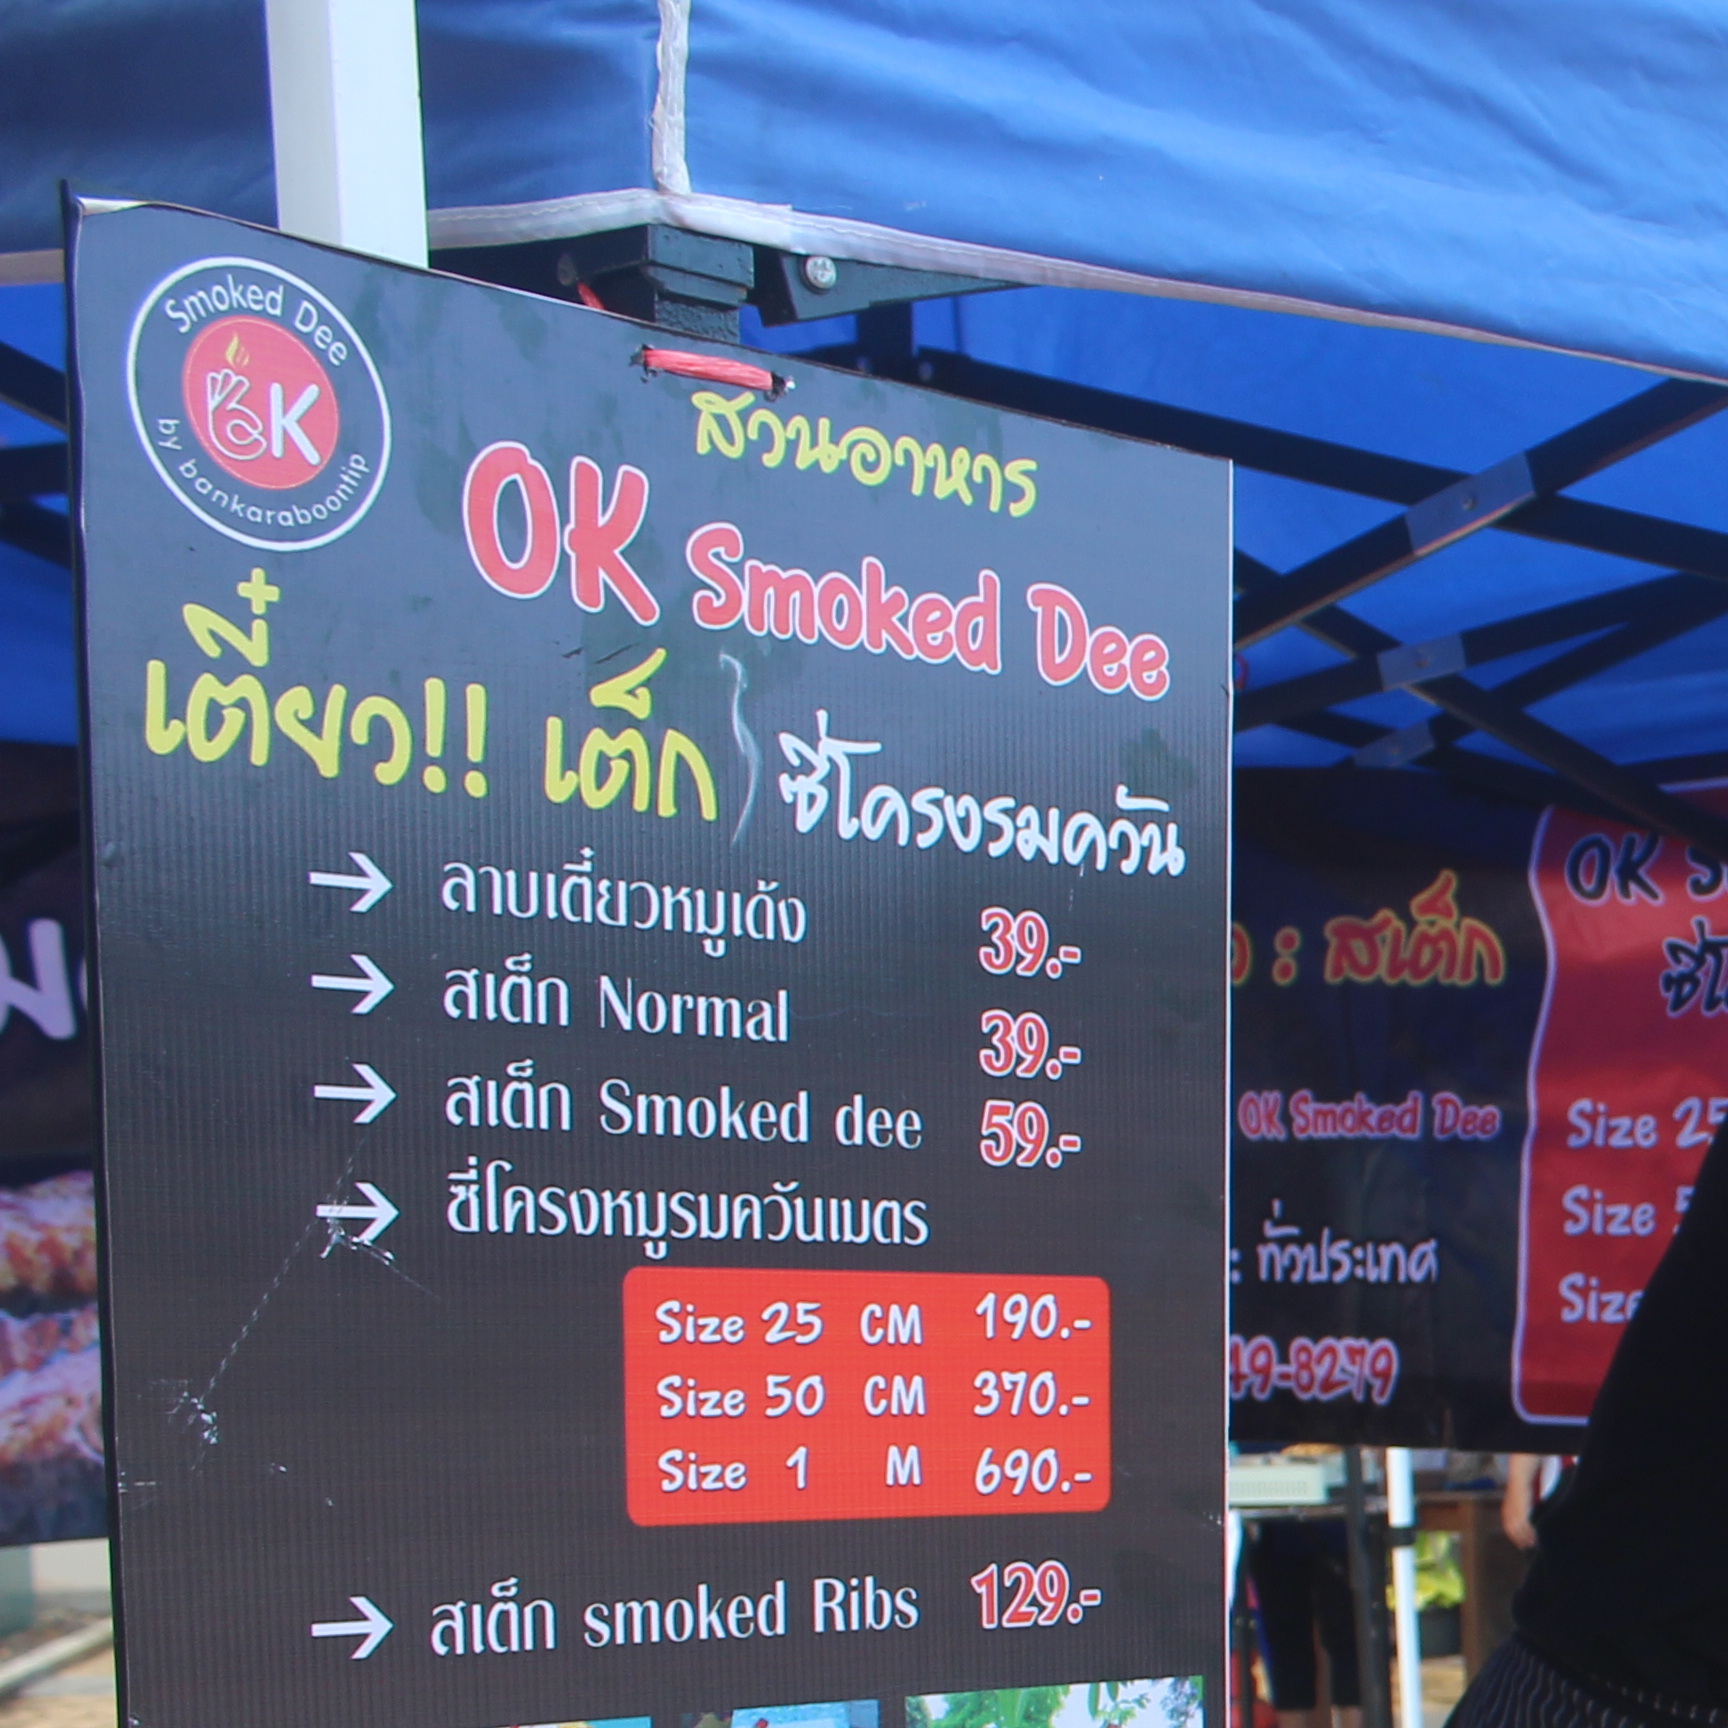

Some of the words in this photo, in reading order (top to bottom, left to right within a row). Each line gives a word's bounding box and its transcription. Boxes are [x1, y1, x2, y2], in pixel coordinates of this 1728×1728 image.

[165, 274, 284, 334] Smoked
[295, 300, 348, 366] Dee
[157, 417, 183, 451] by
[691, 391, 1038, 517] สวนอาหาร
[463, 440, 661, 627] OK
[685, 522, 1002, 675] Smoked
[1026, 582, 1171, 701] Dee
[778, 708, 1187, 877] ซี่โครงรมควัน
[1564, 830, 1666, 908] OK
[978, 906, 1082, 979] 39.-
[1322, 867, 1505, 987] สเต็ก
[443, 952, 570, 1027] สเต็ก
[599, 974, 789, 1042] Normal
[978, 1008, 1082, 1081] 39.-
[445, 1058, 573, 1132] สเต็ก
[600, 1078, 809, 1143] Smoked
[834, 1092, 924, 1150] dee
[978, 1098, 1082, 1169] 59.-
[1238, 1089, 1287, 1141] OK
[1289, 1089, 1423, 1141] Smoked
[1432, 1090, 1502, 1141] Dee
[1566, 1097, 1660, 1150] Size
[445, 1154, 930, 1260] ซี่โครงหมูรมควันเมตร
[1256, 1198, 1439, 1285] ทั่วประเทศ
[1560, 1182, 1657, 1238] Size
[654, 1299, 745, 1344] Size
[760, 1301, 824, 1344] 25
[859, 1303, 924, 1345] CM
[974, 1292, 1091, 1340] 190.-
[655, 1374, 746, 1418] Size
[763, 1374, 826, 1418] 50
[863, 1374, 927, 1417] CM
[971, 1371, 1090, 1418] 370.-
[656, 1448, 747, 1492] Size
[785, 1445, 809, 1489] 1
[885, 1444, 922, 1487] M
[974, 1447, 1092, 1496] 690.-
[430, 1576, 557, 1657] สเต็ก
[582, 1580, 786, 1648] smoked
[812, 1575, 919, 1634] Ribs
[969, 1559, 1101, 1630] 129.-
